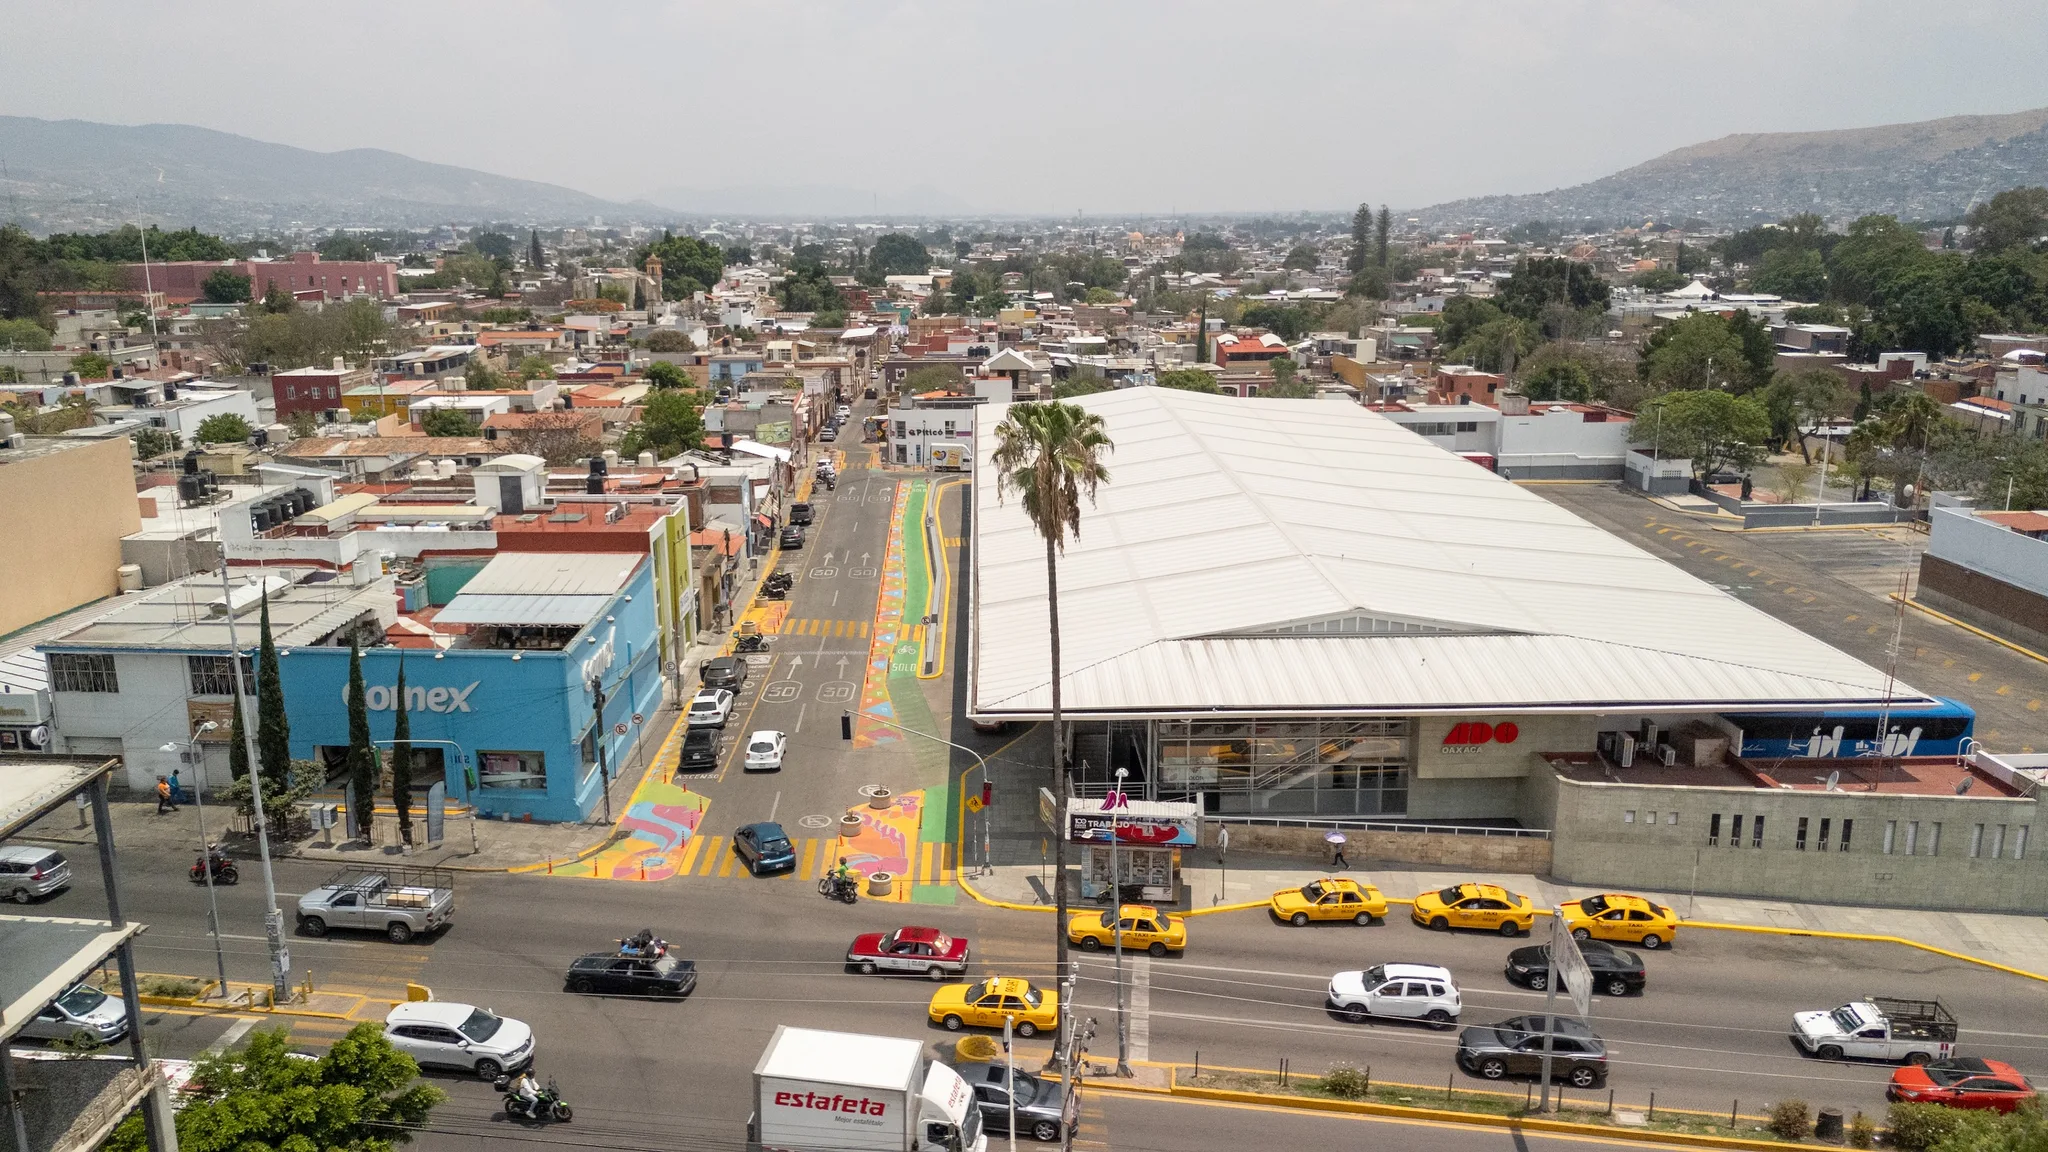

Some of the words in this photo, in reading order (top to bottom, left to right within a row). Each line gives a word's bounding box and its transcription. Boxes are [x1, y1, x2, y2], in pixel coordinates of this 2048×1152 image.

[892, 663, 917, 672] SOLO
[1443, 722, 1519, 744] ADO
[775, 1091, 886, 1117] estafeta
[834, 1115, 852, 1124] Mejor
